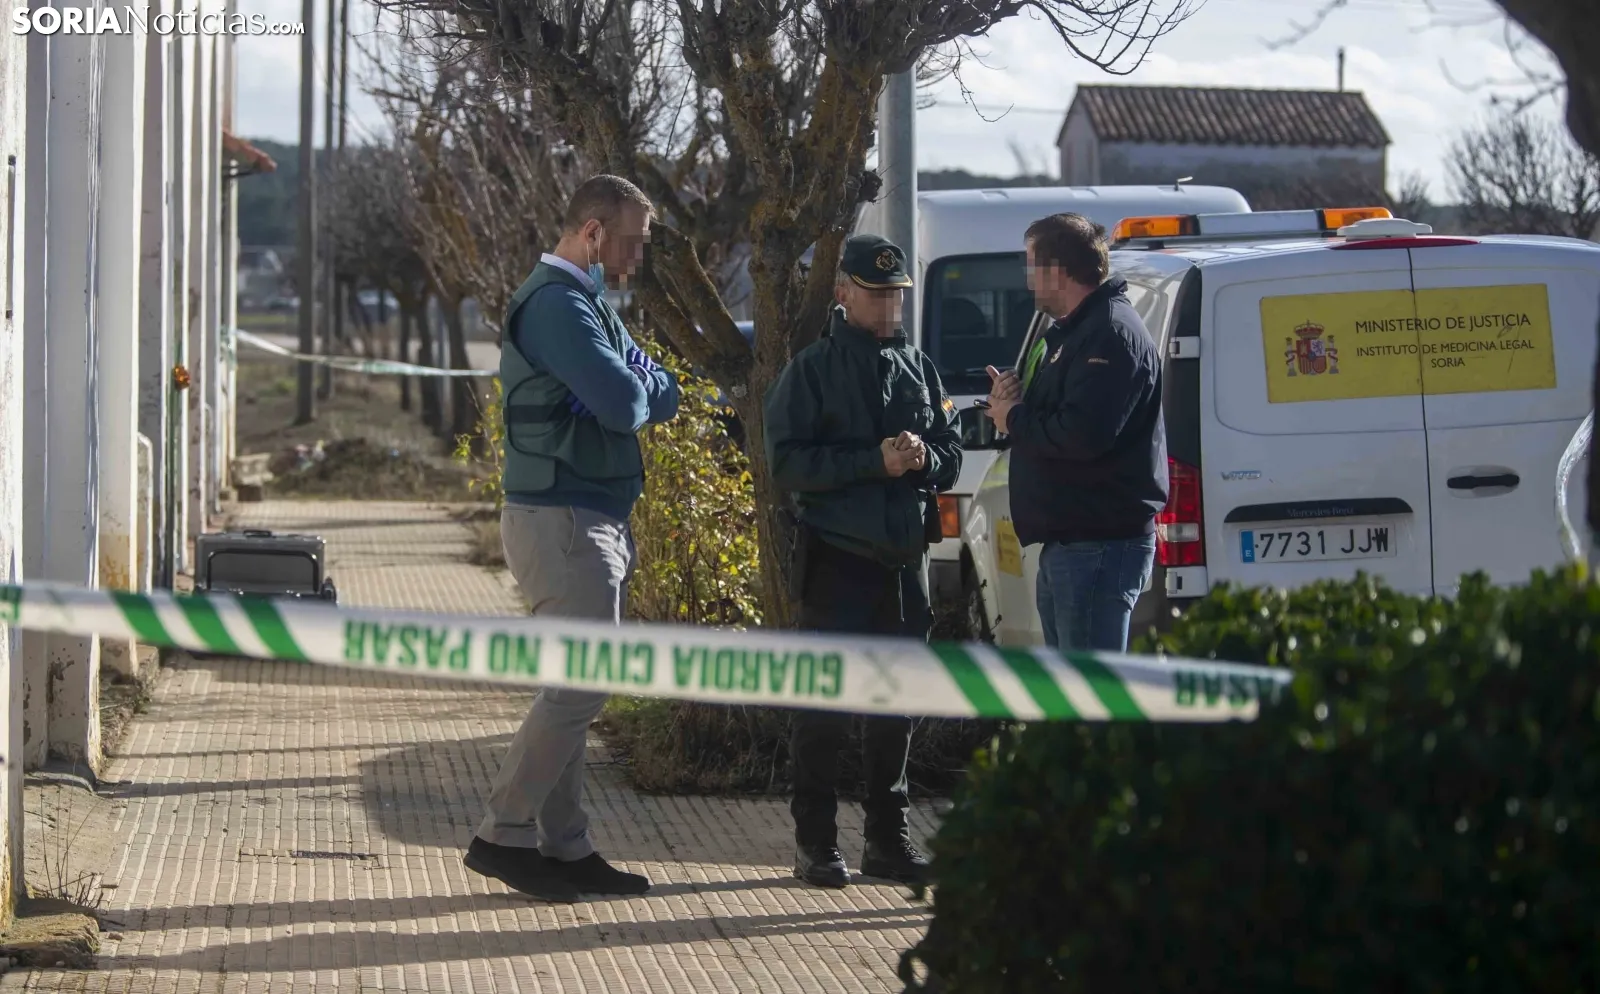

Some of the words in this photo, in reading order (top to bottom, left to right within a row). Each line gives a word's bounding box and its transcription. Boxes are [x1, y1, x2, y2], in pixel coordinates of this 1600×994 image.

[1356, 317, 1441, 334] MINISTERIO
[1446, 316, 1466, 330] DE
[1469, 313, 1531, 332] JUSTICIA
[1356, 344, 1418, 357] INSTITUTO
[1422, 343, 1438, 354] DE
[1440, 341, 1496, 353] MEDICINA
[1500, 339, 1535, 350] LEGAL
[1430, 357, 1466, 369] SORIA
[1259, 530, 1326, 558] 7731
[1340, 527, 1389, 554] JJW
[344, 619, 472, 671] PASAR
[488, 631, 541, 676] NO
[558, 634, 656, 686] CIVIL
[672, 645, 844, 698] GUARDIA
